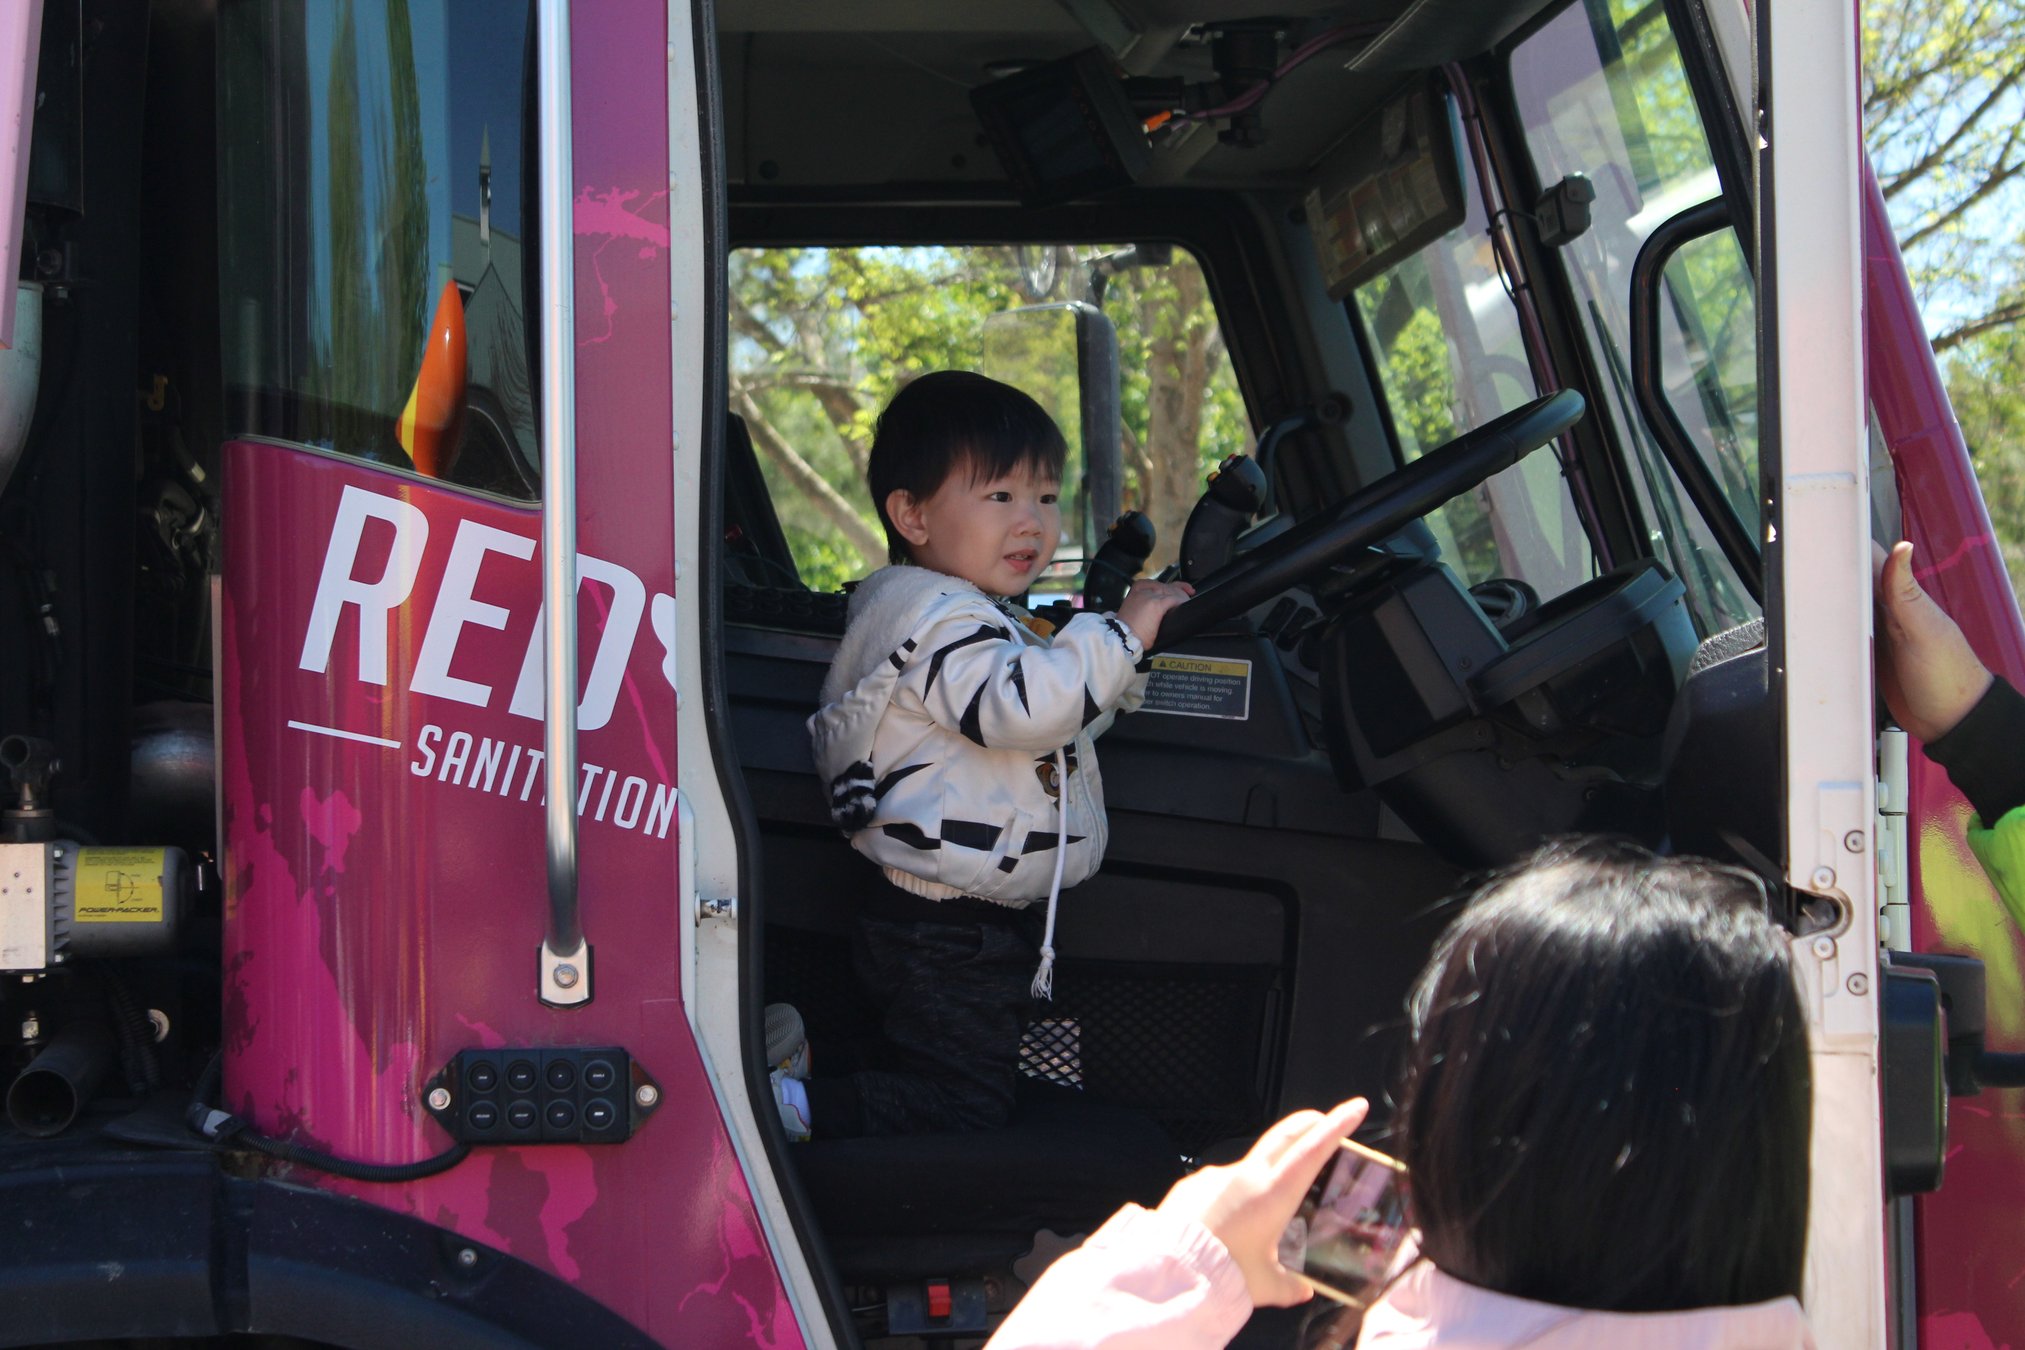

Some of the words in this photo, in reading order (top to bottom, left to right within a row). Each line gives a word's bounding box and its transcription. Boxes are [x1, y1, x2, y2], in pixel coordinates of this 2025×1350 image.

[1169, 662, 1211, 672] CAUTION
[1162, 673, 1189, 682] operate
[1190, 674, 1213, 684] driving
[1214, 678, 1241, 686] position
[1175, 683, 1198, 691] vehicle
[410, 725, 678, 839] SANITTION
